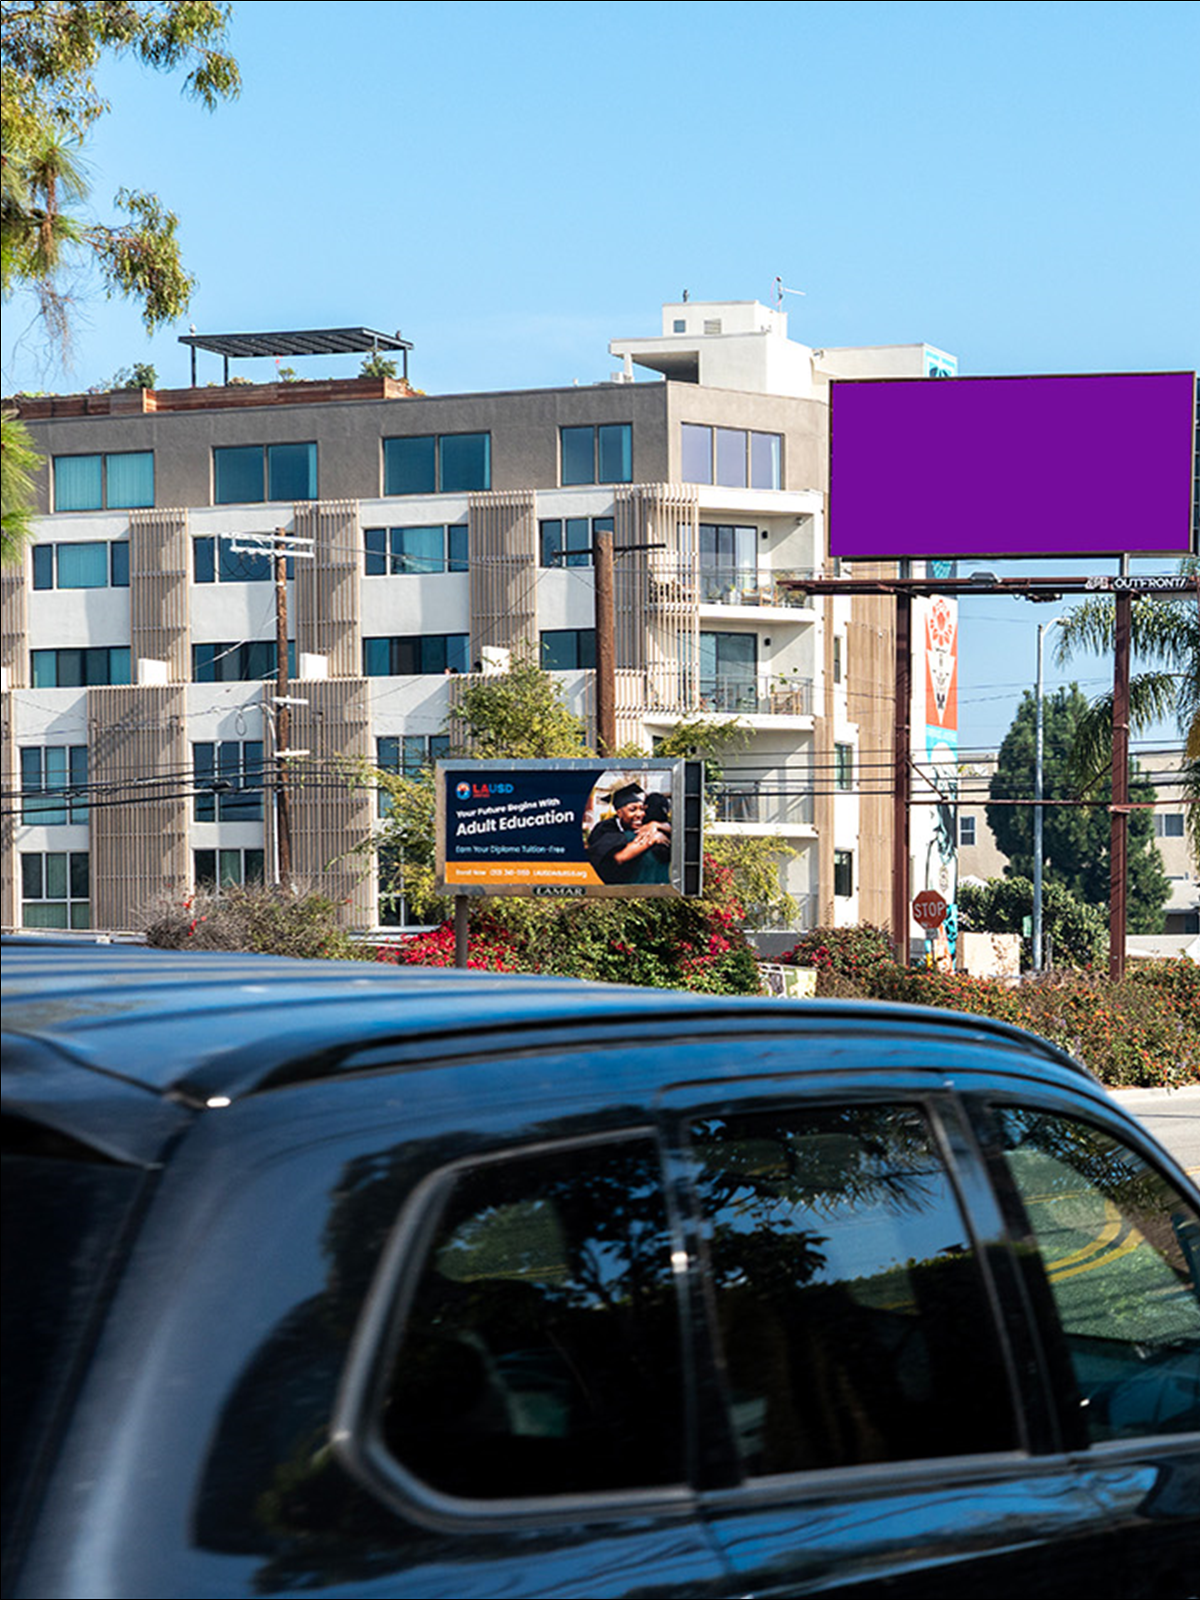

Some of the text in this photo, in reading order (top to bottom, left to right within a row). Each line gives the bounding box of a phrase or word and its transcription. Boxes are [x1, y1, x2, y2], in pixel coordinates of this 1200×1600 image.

[472, 783, 514, 794] LAUSD
[456, 797, 561, 818] Your Future Begins With
[456, 809, 574, 836] Adult Education
[536, 886, 583, 896] LAMAR
[914, 901, 945, 918] STOP
